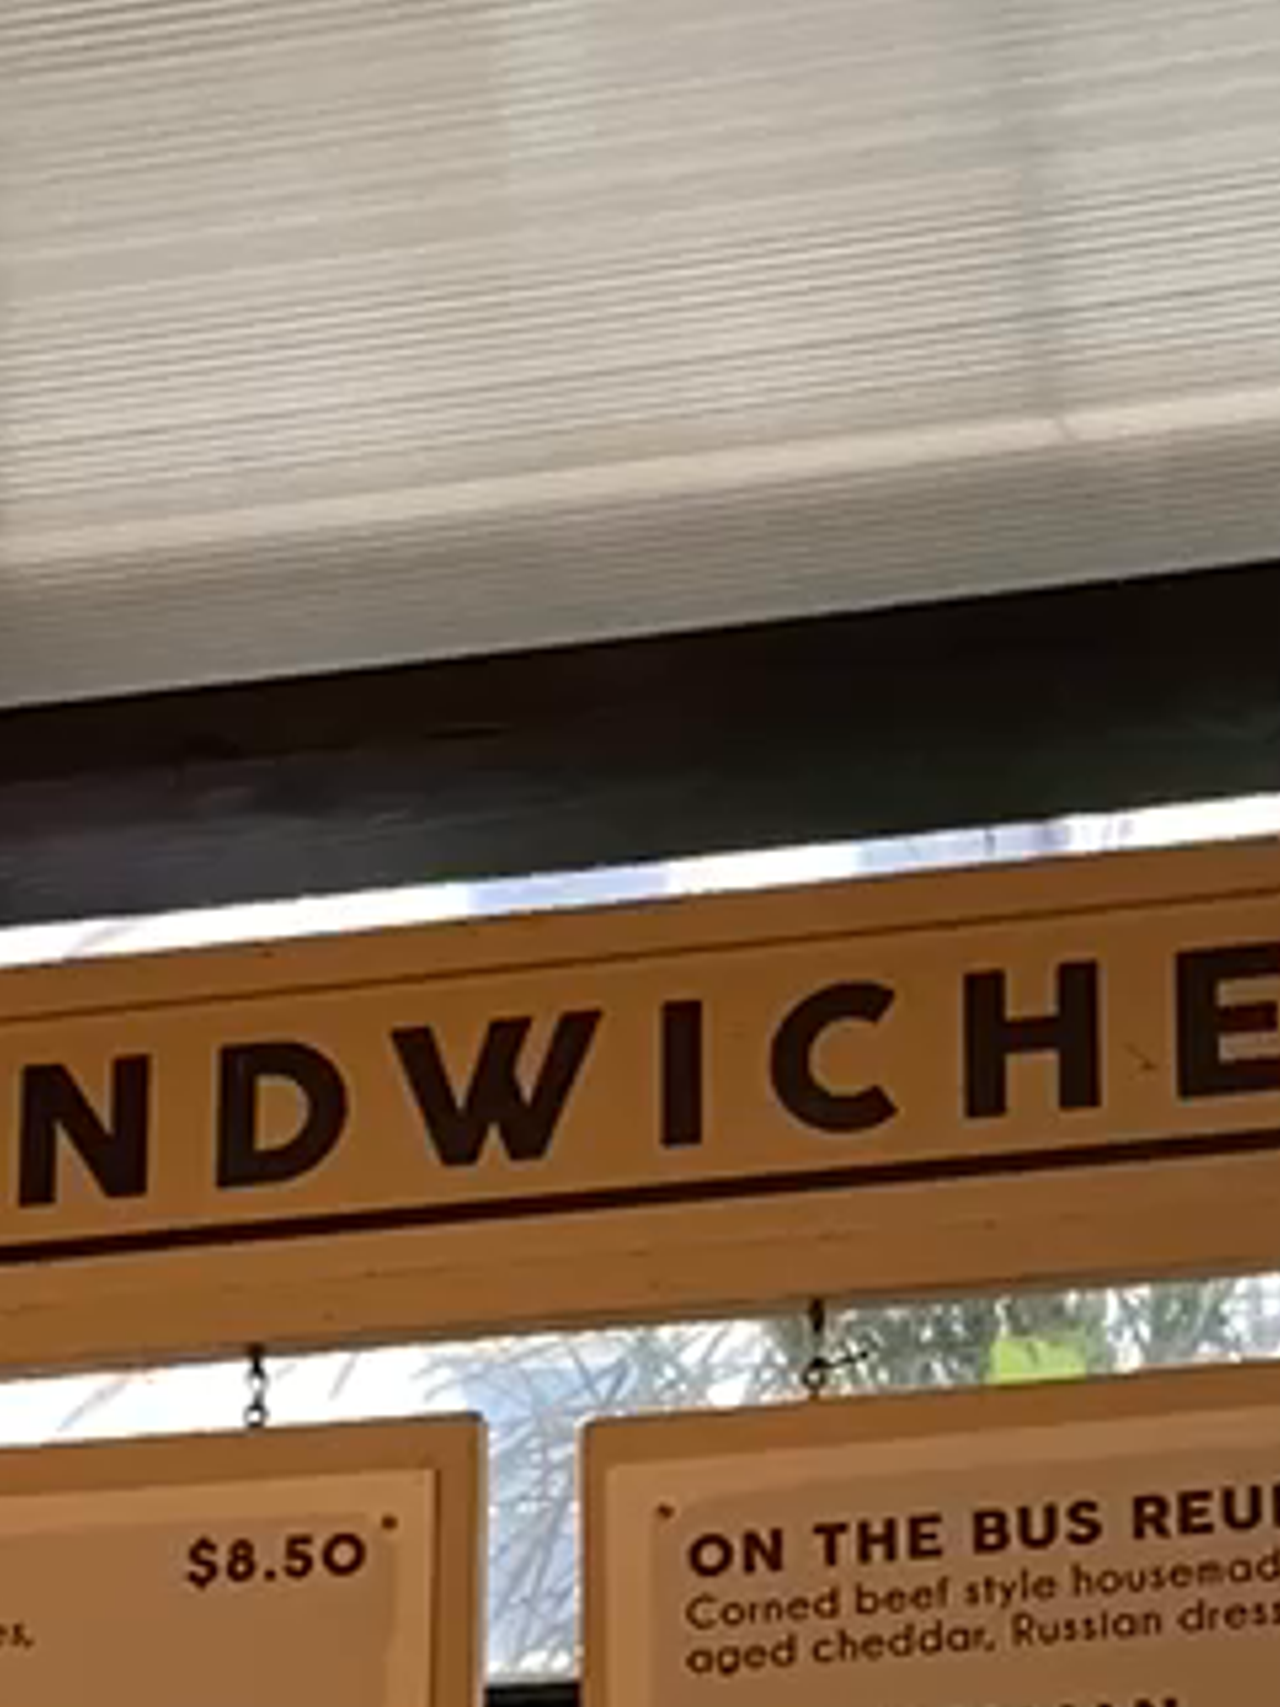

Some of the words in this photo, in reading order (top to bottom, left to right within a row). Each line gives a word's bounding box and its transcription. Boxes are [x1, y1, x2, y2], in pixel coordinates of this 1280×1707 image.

[184, 1530, 369, 1593] $8.50
[684, 1525, 786, 1581] ON
[809, 1510, 946, 1570] THE
[970, 1497, 1105, 1558] BUS
[683, 1581, 843, 1633] Corned
[852, 1573, 952, 1619] beef
[962, 1564, 1061, 1613] style
